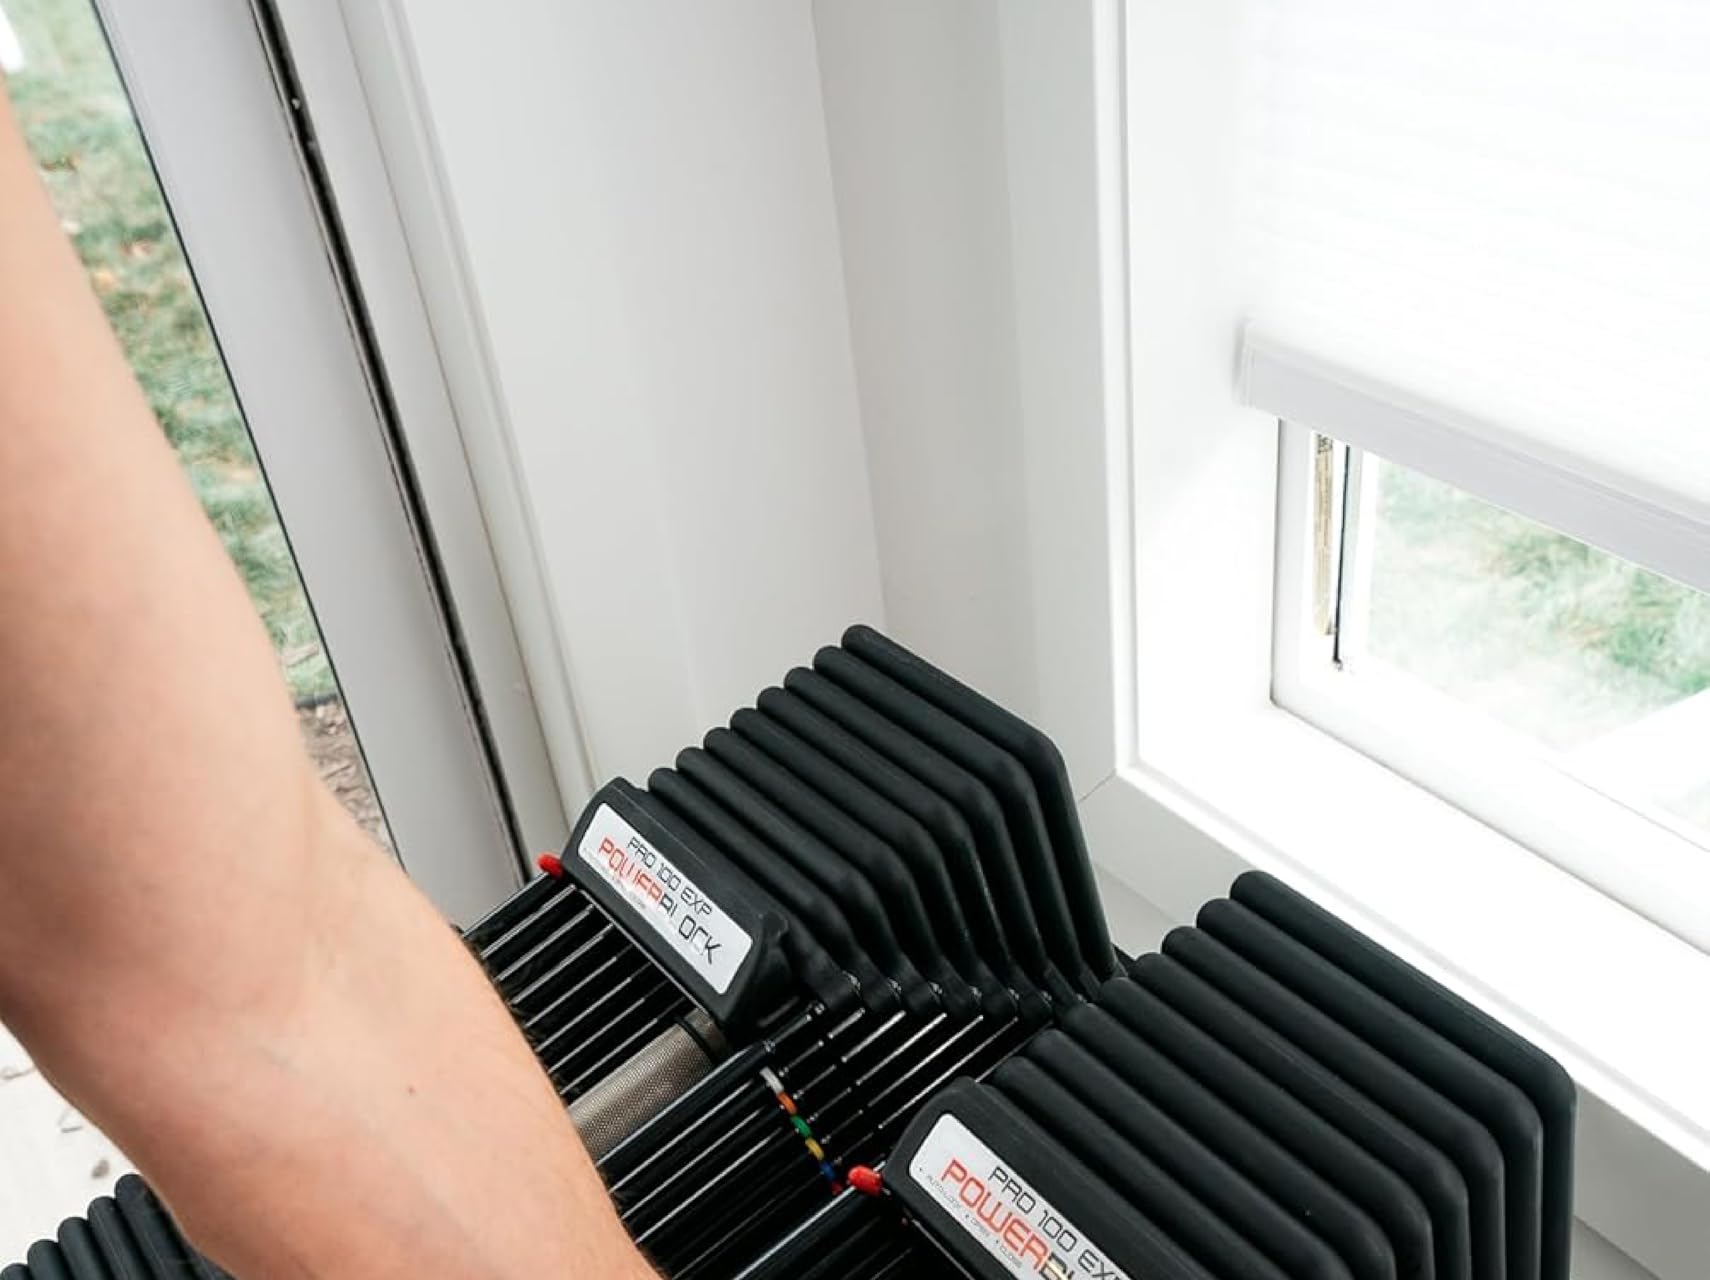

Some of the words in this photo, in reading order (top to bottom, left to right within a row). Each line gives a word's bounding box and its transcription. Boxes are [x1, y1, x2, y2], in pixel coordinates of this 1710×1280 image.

[627, 836, 656, 869] PRO
[656, 863, 681, 891] 100
[680, 888, 712, 916] EXP
[988, 1165, 1036, 1214] PRO
[1037, 1210, 1077, 1252] 100
